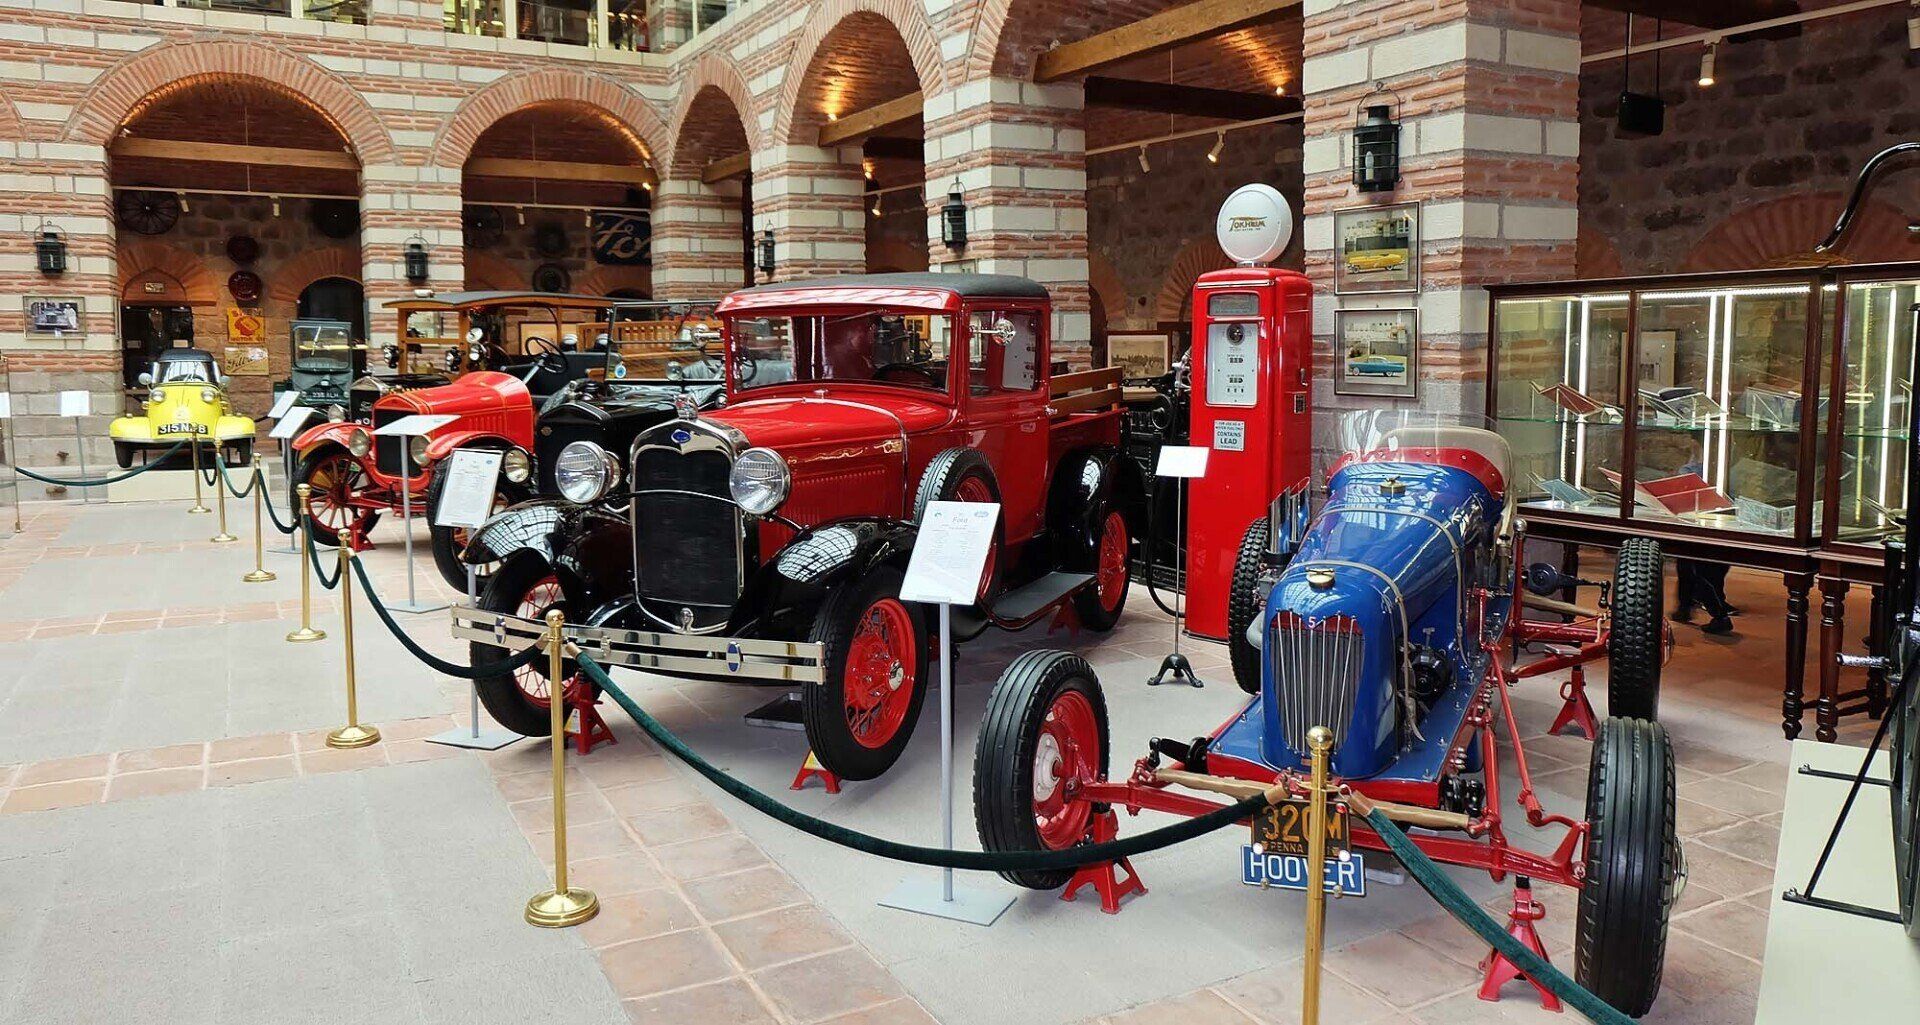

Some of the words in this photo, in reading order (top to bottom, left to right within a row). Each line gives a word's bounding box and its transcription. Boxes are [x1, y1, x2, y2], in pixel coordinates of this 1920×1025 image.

[1228, 216, 1268, 232] TOKHEIM
[594, 213, 652, 260] Fo
[159, 423, 179, 434] 315
[1308, 616, 1317, 627] 5
[1270, 842, 1303, 853] PENNA
